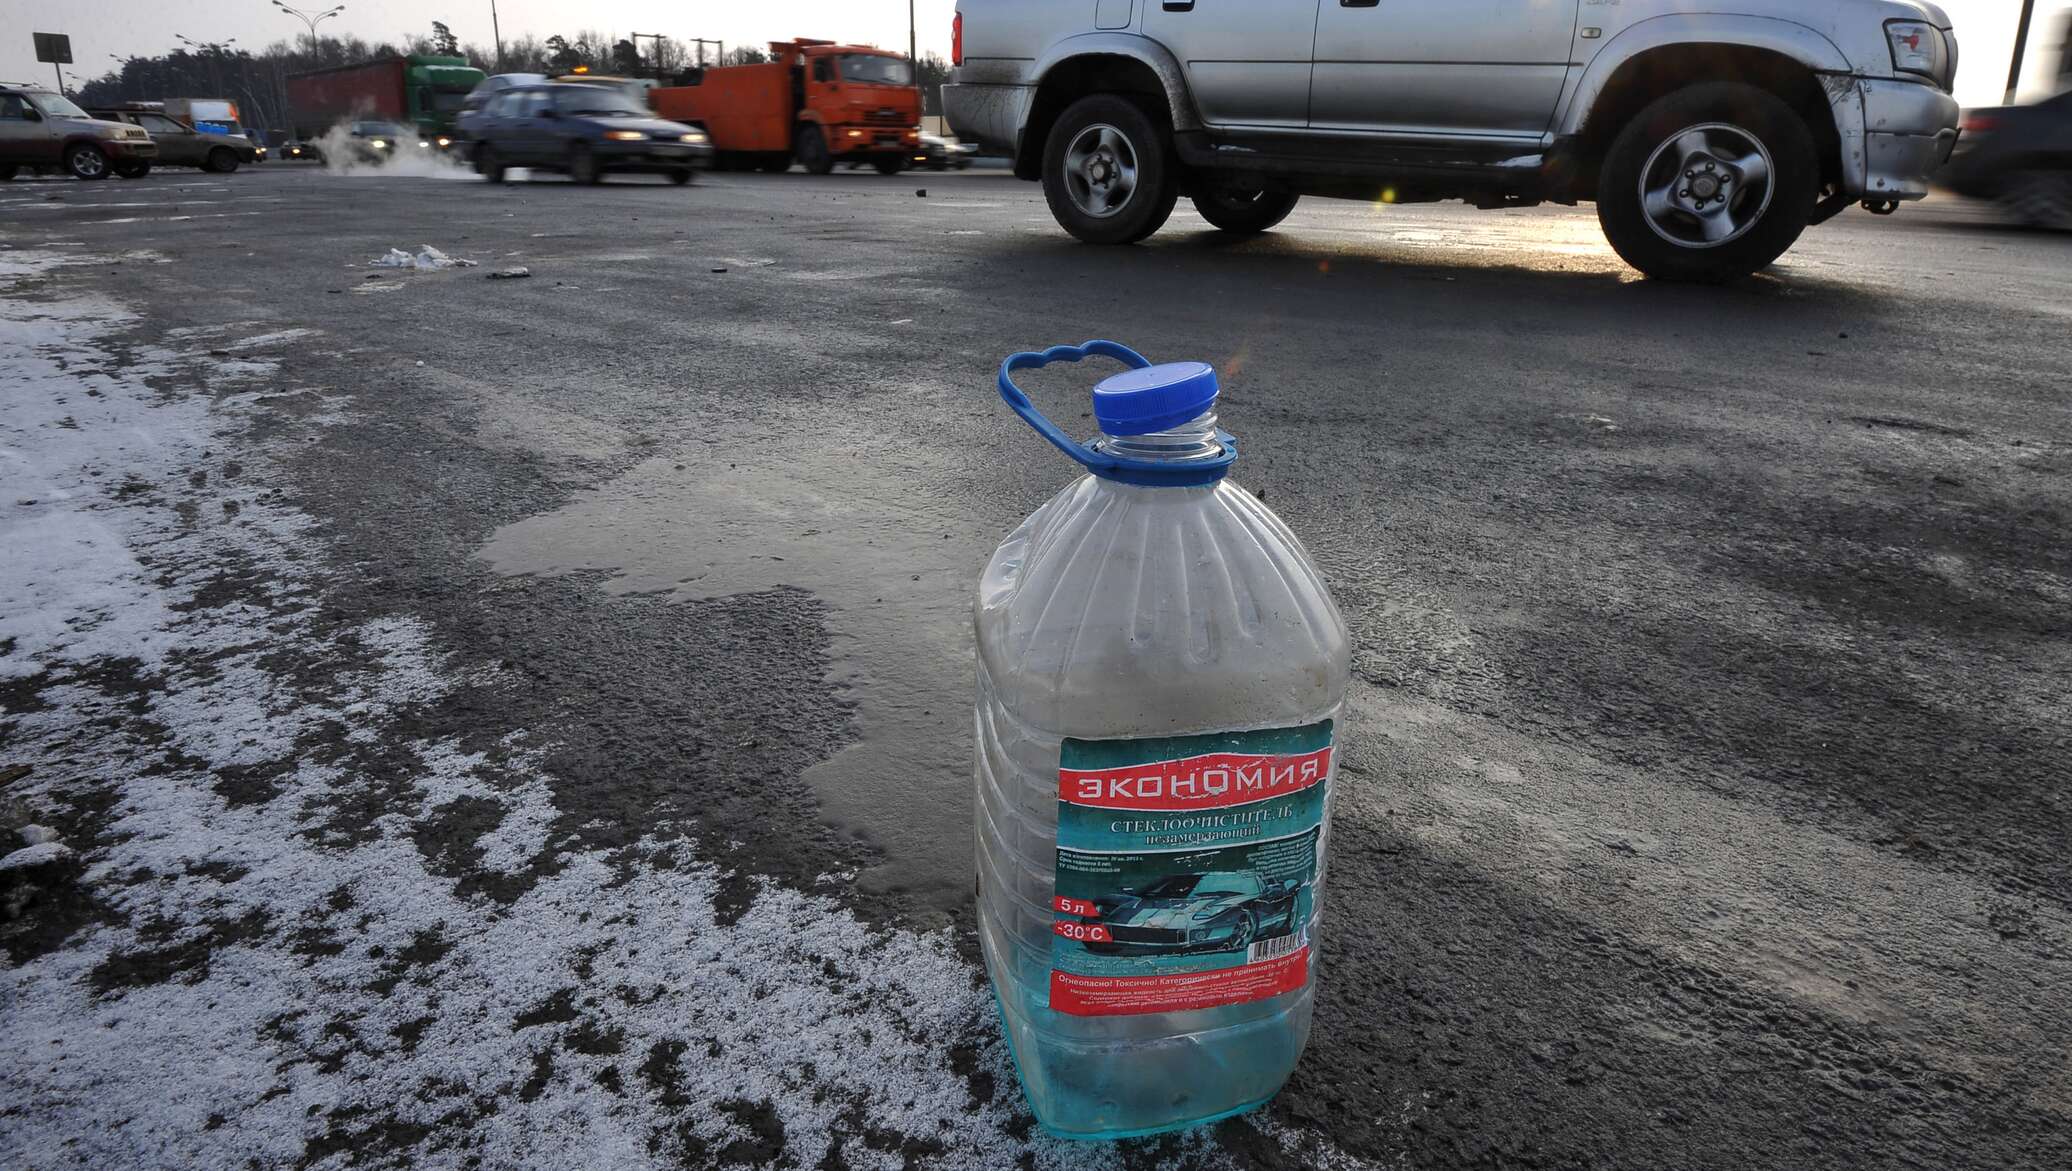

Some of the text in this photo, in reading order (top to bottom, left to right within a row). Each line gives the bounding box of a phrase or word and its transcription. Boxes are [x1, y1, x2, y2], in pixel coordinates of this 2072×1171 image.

[1078, 758, 1318, 799] ЭКОНОМИЯ
[1110, 804, 1293, 833] СТЕКЛООЧИСТИТЕЛЬ
[1146, 823, 1261, 845] незамерзающий
[1060, 898, 1085, 914] 5 л
[1058, 974, 1113, 987] Огнеопасно!
[1116, 979, 1158, 988] Токсично!
